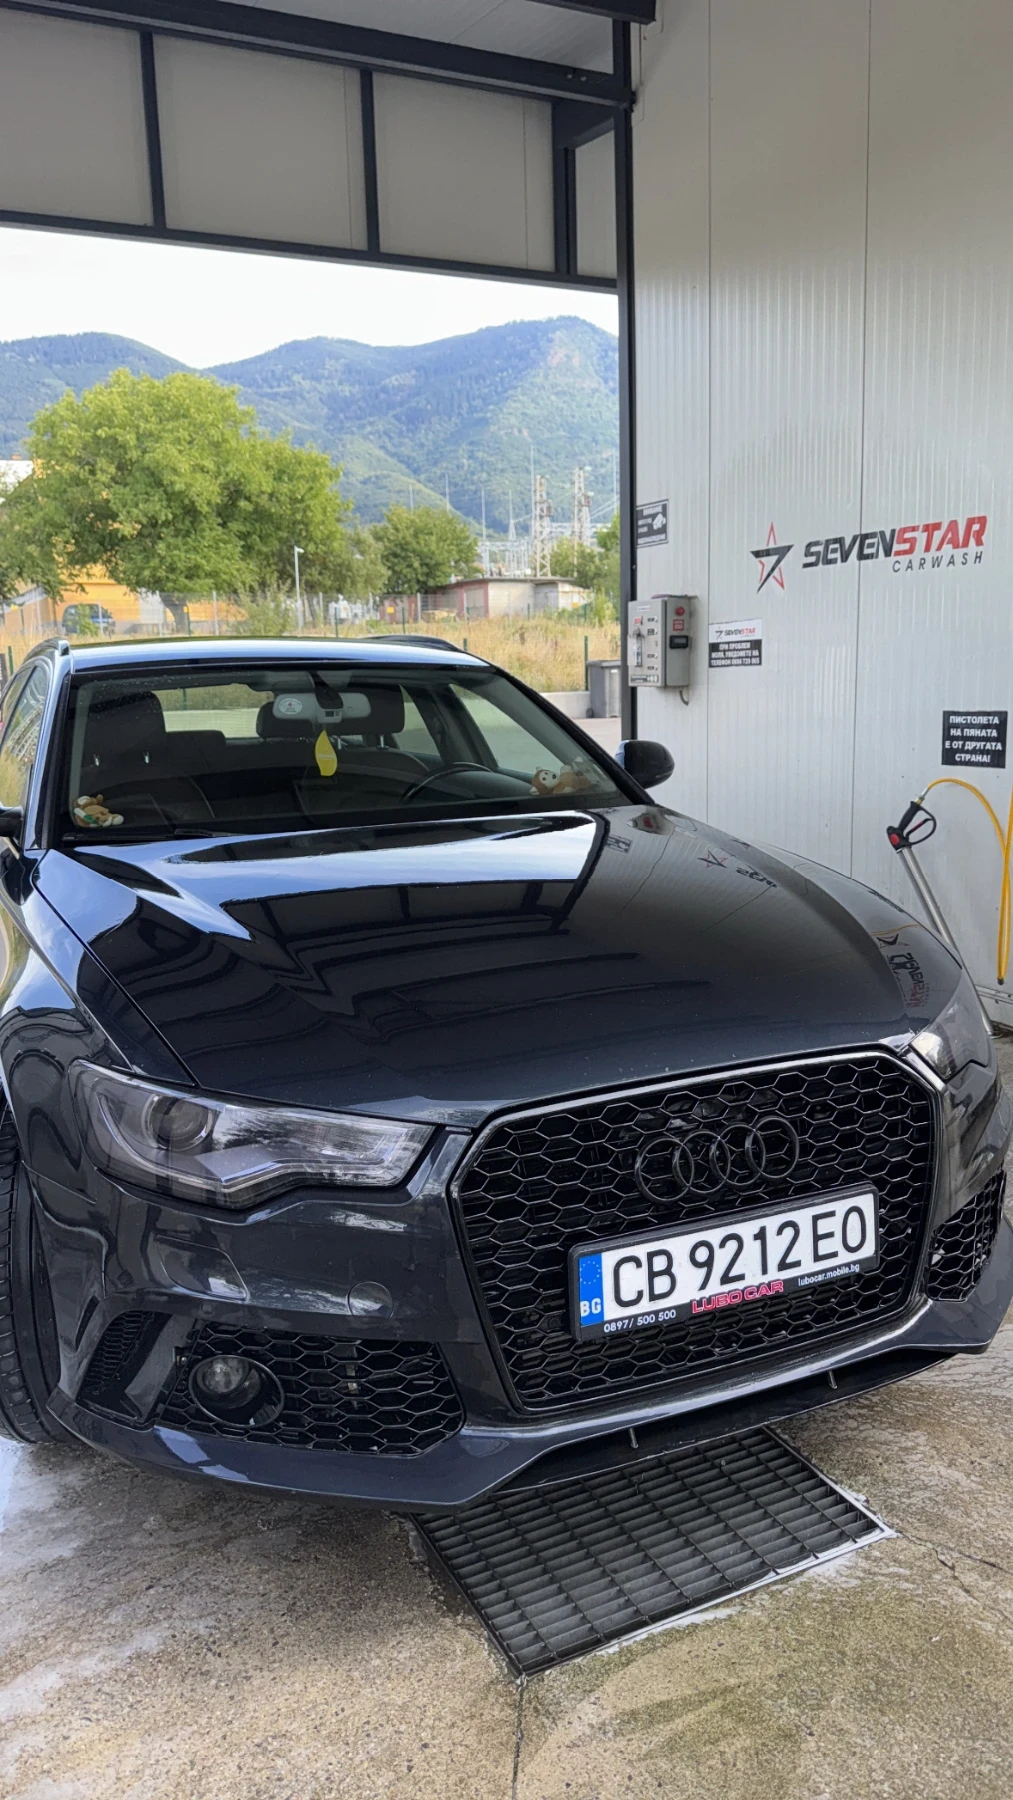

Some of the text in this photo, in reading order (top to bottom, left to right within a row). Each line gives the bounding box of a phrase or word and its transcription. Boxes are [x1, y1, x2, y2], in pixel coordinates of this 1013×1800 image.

[802, 515, 988, 569] SEVENSTAR
[892, 551, 983, 573] CARWASH
[949, 715, 1000, 724] ПИСТОЛЕТА
[950, 728, 998, 738] НА ПЯНАТА
[952, 740, 964, 749] ОТ
[964, 741, 1003, 751] ДРУГАТА
[955, 753, 991, 763] СТРАНА!
[689, 1219, 802, 1292] 9212
[798, 1263, 860, 1287] lubocar.mobile.bg
[580, 1297, 602, 1317] BG
[691, 1280, 784, 1314] LUBO CAR
[637, 1313, 656, 1327] 500
[658, 1309, 677, 1324] 500
